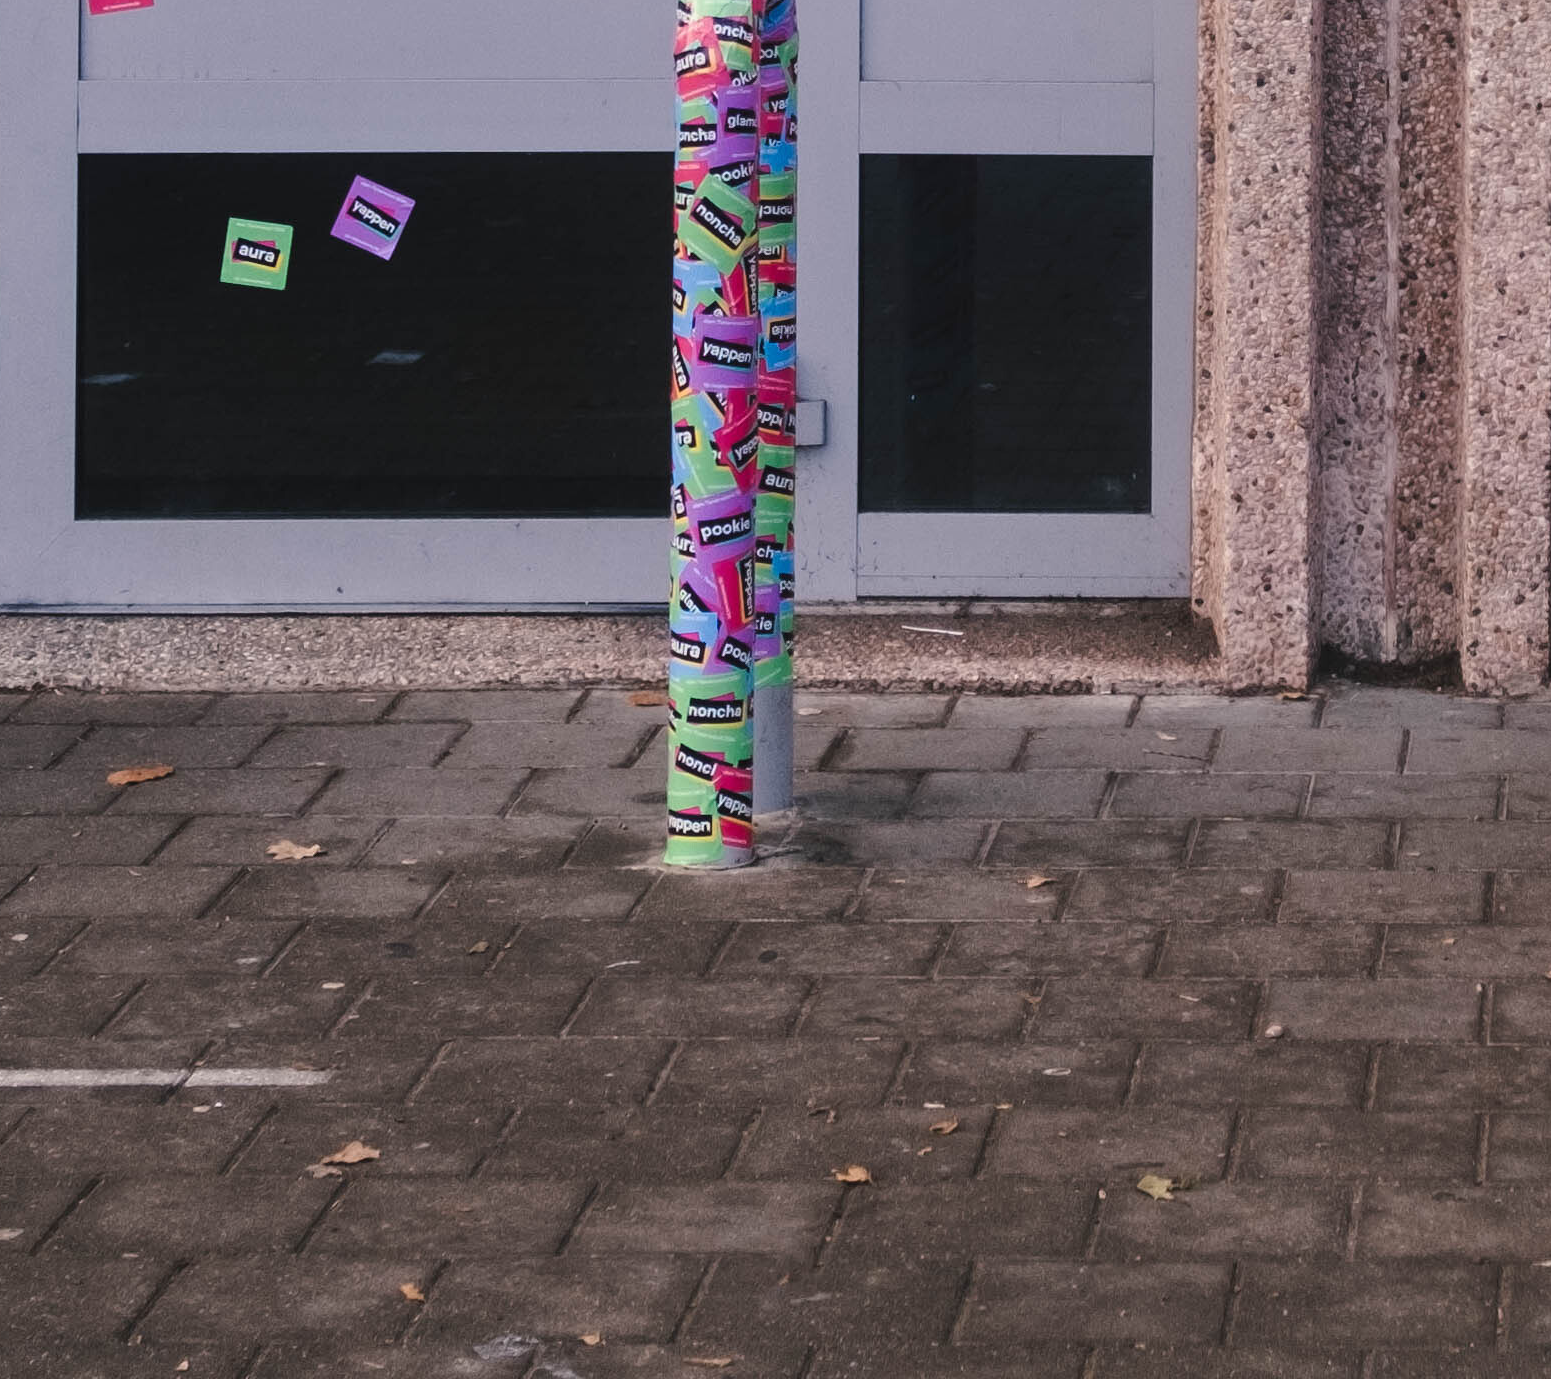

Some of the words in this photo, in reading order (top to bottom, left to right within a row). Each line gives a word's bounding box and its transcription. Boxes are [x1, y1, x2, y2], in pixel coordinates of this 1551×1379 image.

[352, 200, 395, 233] yappen
[695, 204, 743, 247] noncha
[239, 245, 275, 263] aura
[703, 341, 753, 364] yappen
[693, 704, 741, 718] noncha
